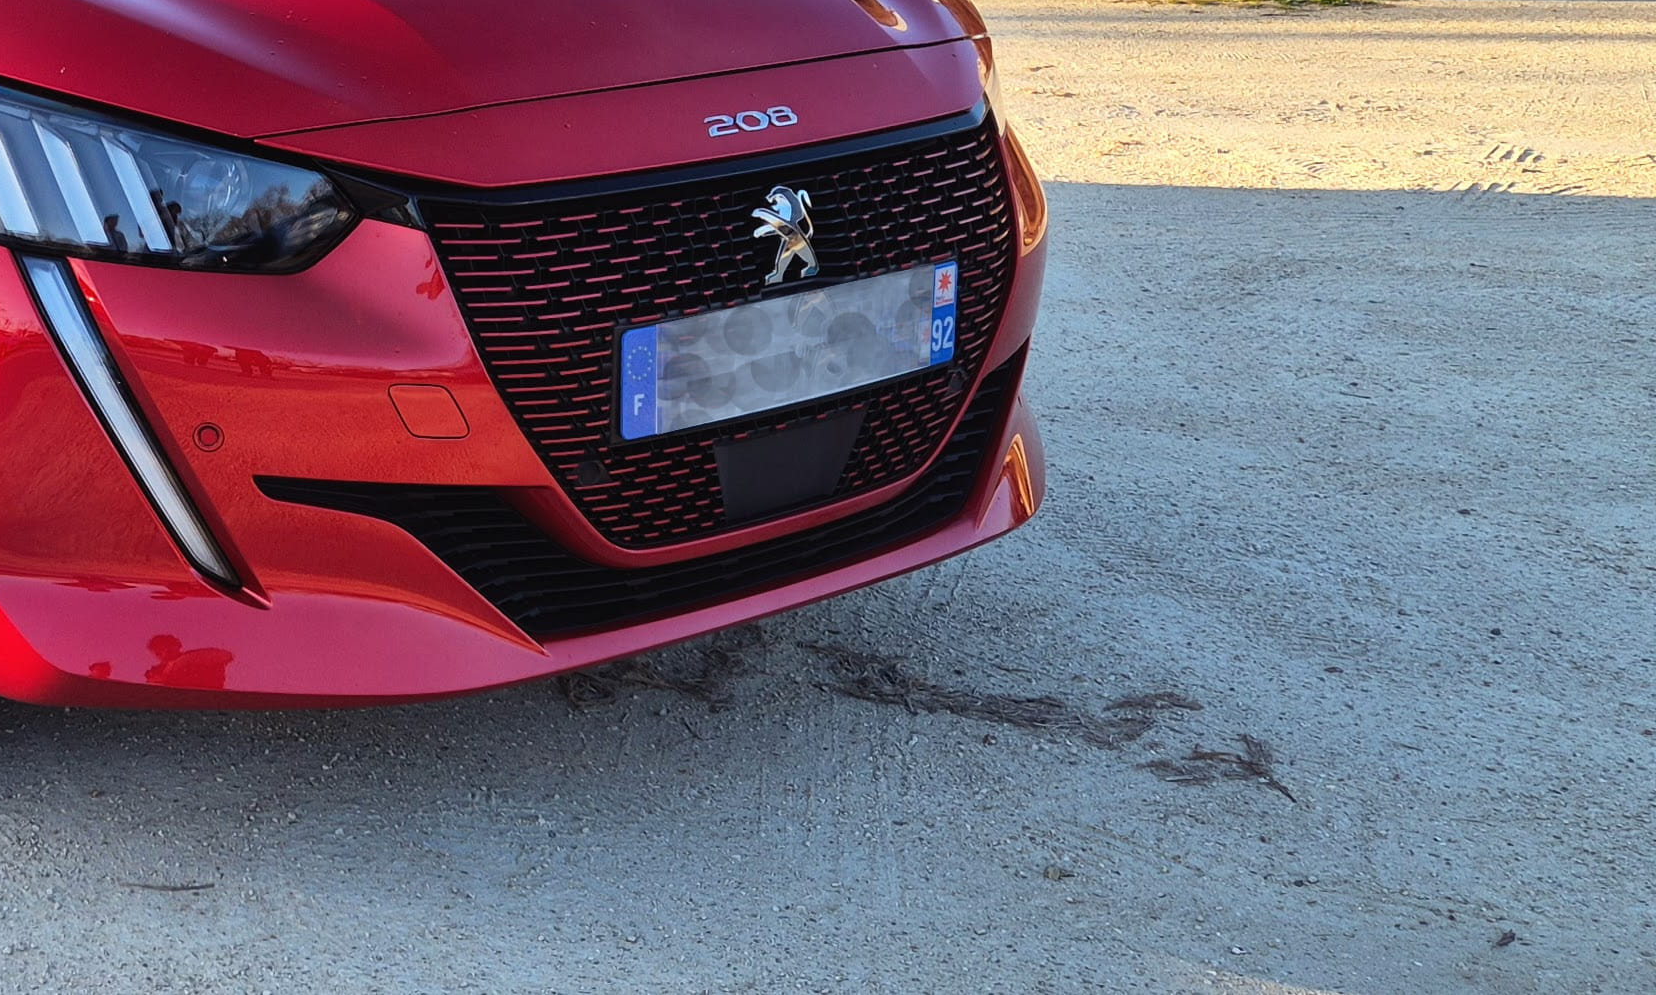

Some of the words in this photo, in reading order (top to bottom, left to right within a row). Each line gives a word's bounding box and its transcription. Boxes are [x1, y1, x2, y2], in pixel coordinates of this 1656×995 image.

[704, 105, 798, 137] 208
[932, 316, 953, 352] 92
[634, 393, 645, 416] F
